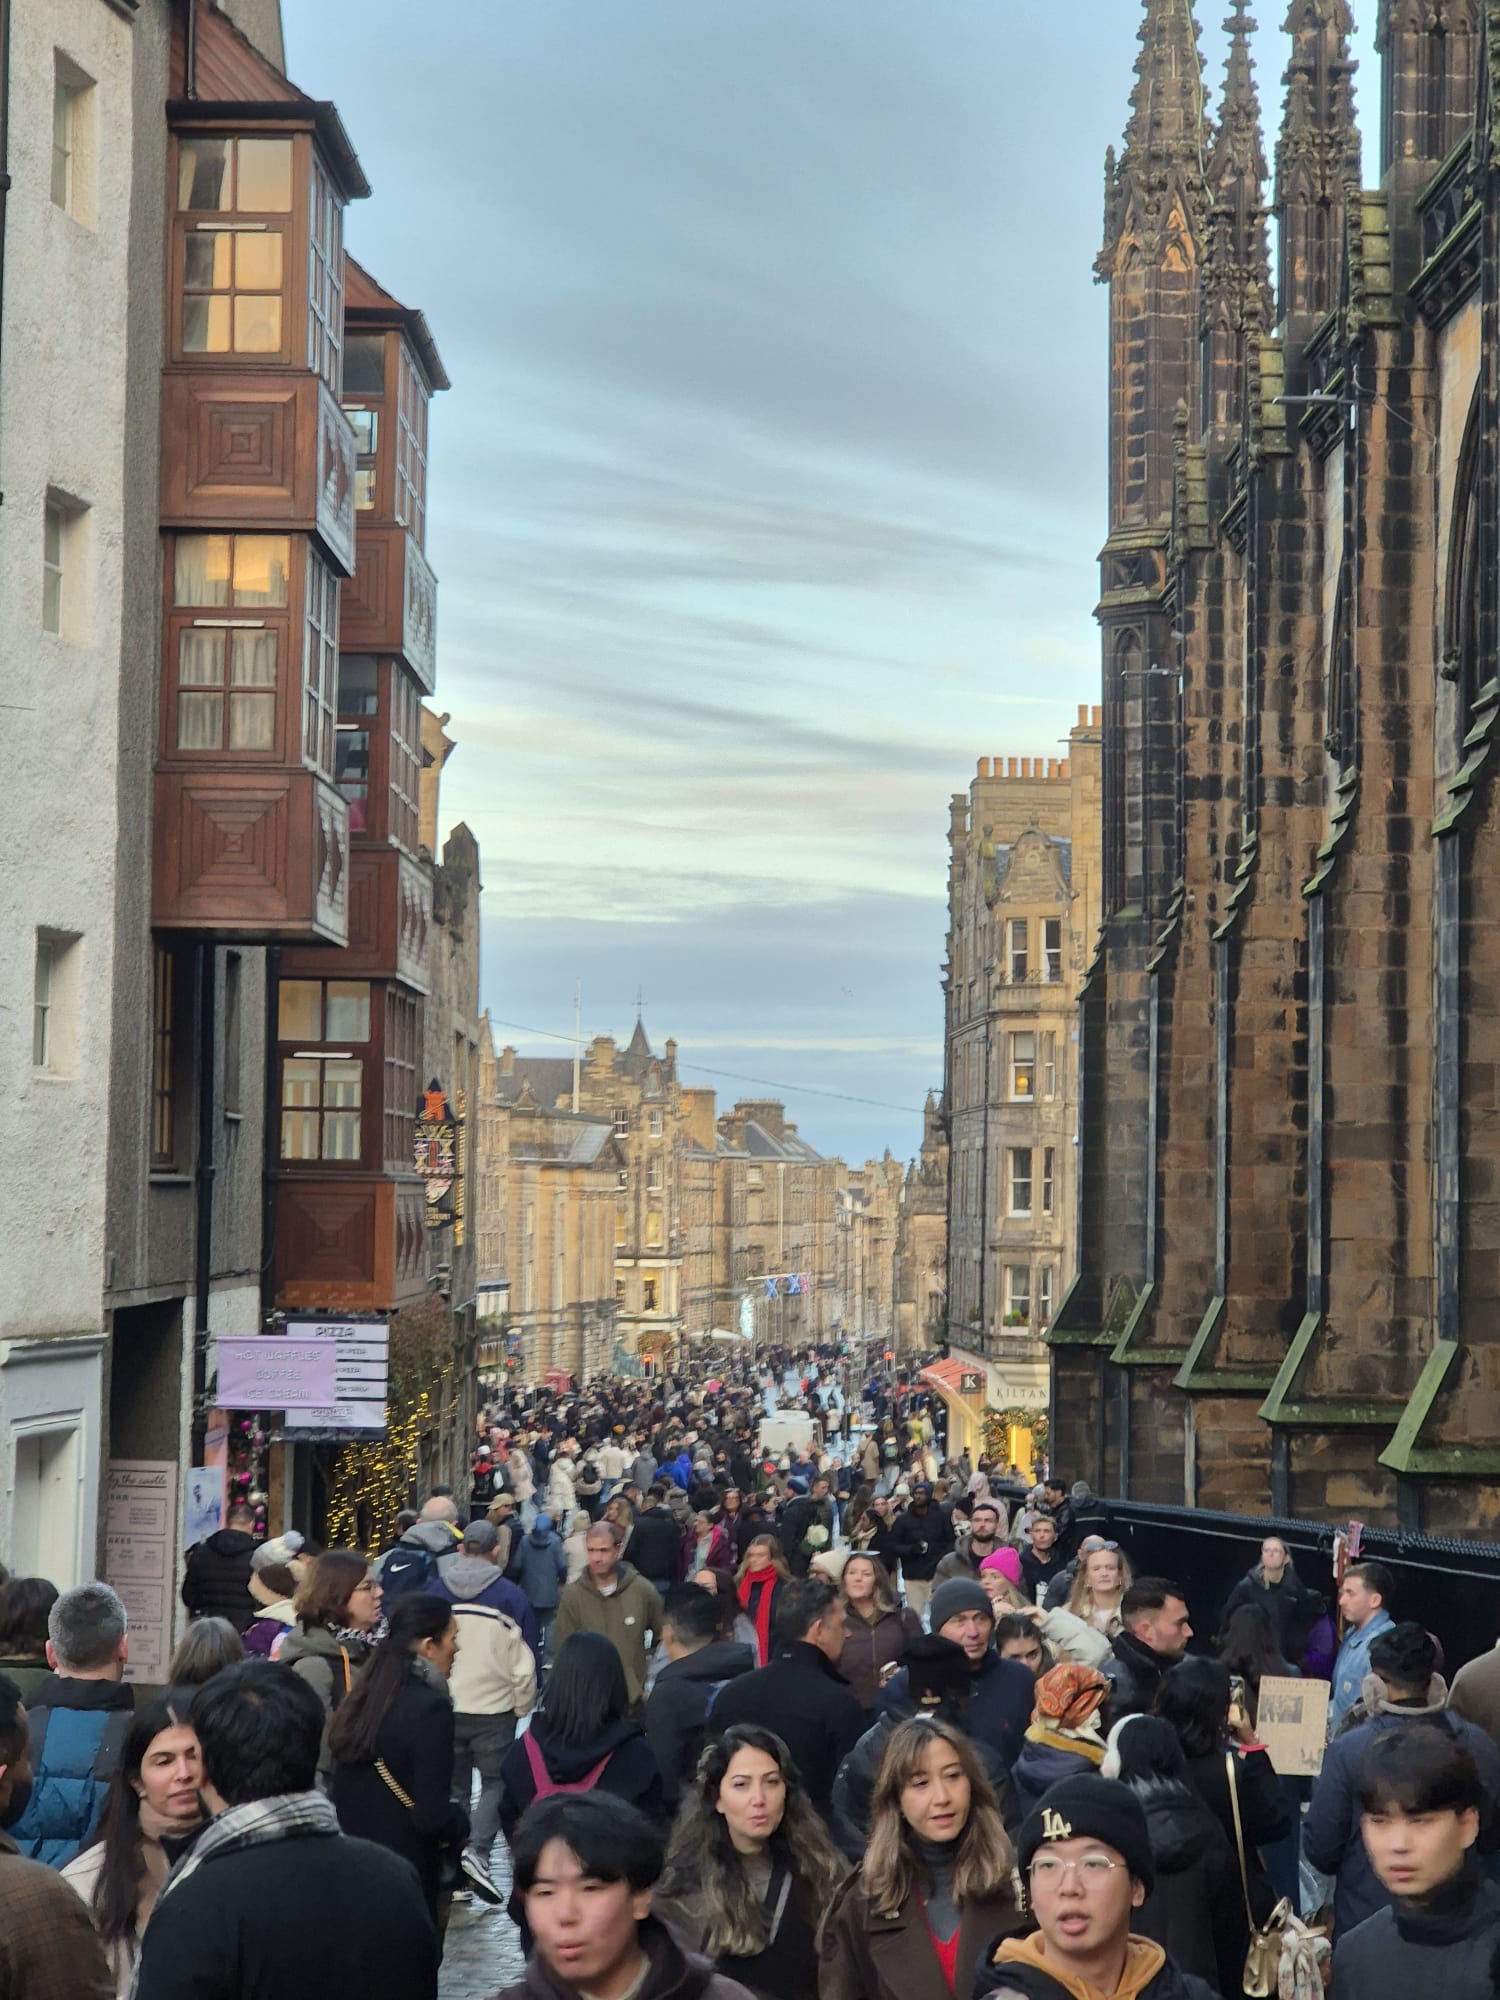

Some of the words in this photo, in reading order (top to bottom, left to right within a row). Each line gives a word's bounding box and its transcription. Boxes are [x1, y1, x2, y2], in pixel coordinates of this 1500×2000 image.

[316, 1327, 355, 1337] PIZZA
[236, 1351, 261, 1361] HOT
[264, 1351, 320, 1361] WAFFLES
[256, 1369, 304, 1380] COFFEE
[965, 1375, 977, 1388] K
[269, 1388, 311, 1400] CREAM
[1041, 1808, 1071, 1840] LA
